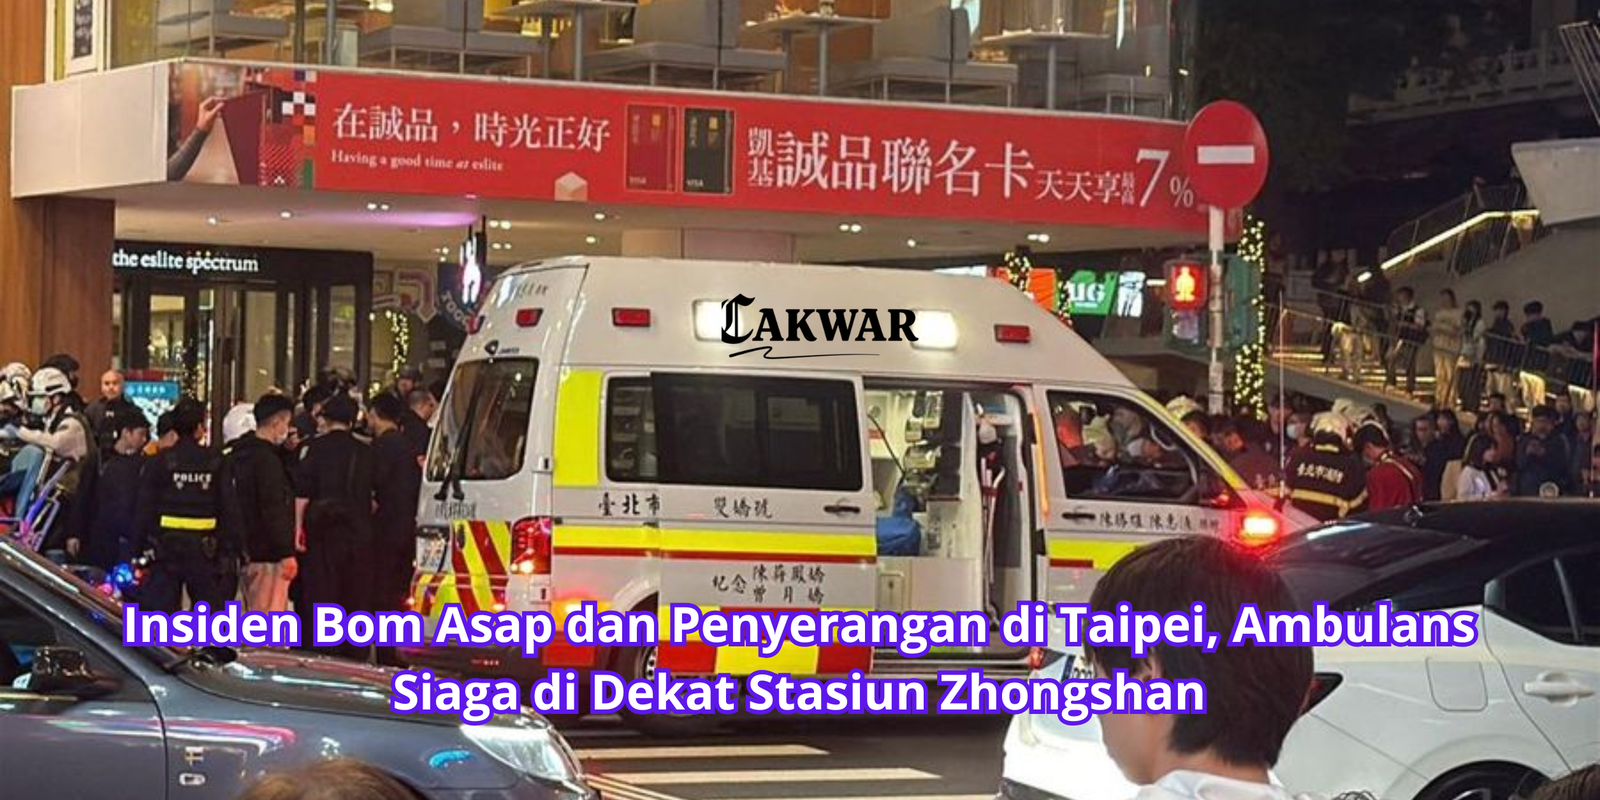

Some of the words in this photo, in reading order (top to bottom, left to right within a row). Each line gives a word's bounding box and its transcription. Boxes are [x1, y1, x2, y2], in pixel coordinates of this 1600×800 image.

[332, 102, 610, 152] 在誠品，時光正好
[331, 150, 377, 167] Having
[379, 156, 388, 165] a
[390, 153, 421, 170] good
[425, 155, 453, 168] time
[455, 158, 469, 170] at
[472, 157, 504, 171] eslite
[748, 127, 774, 188] 凱基
[776, 130, 1035, 198] 誠品聯名卡
[1036, 170, 1121, 203] 天天享
[1121, 171, 1135, 205] 最高
[112, 248, 139, 267] the
[140, 250, 183, 269] eslite
[185, 255, 259, 275] spectrum
[173, 473, 212, 483] POLICE
[598, 492, 661, 516] 臺北市
